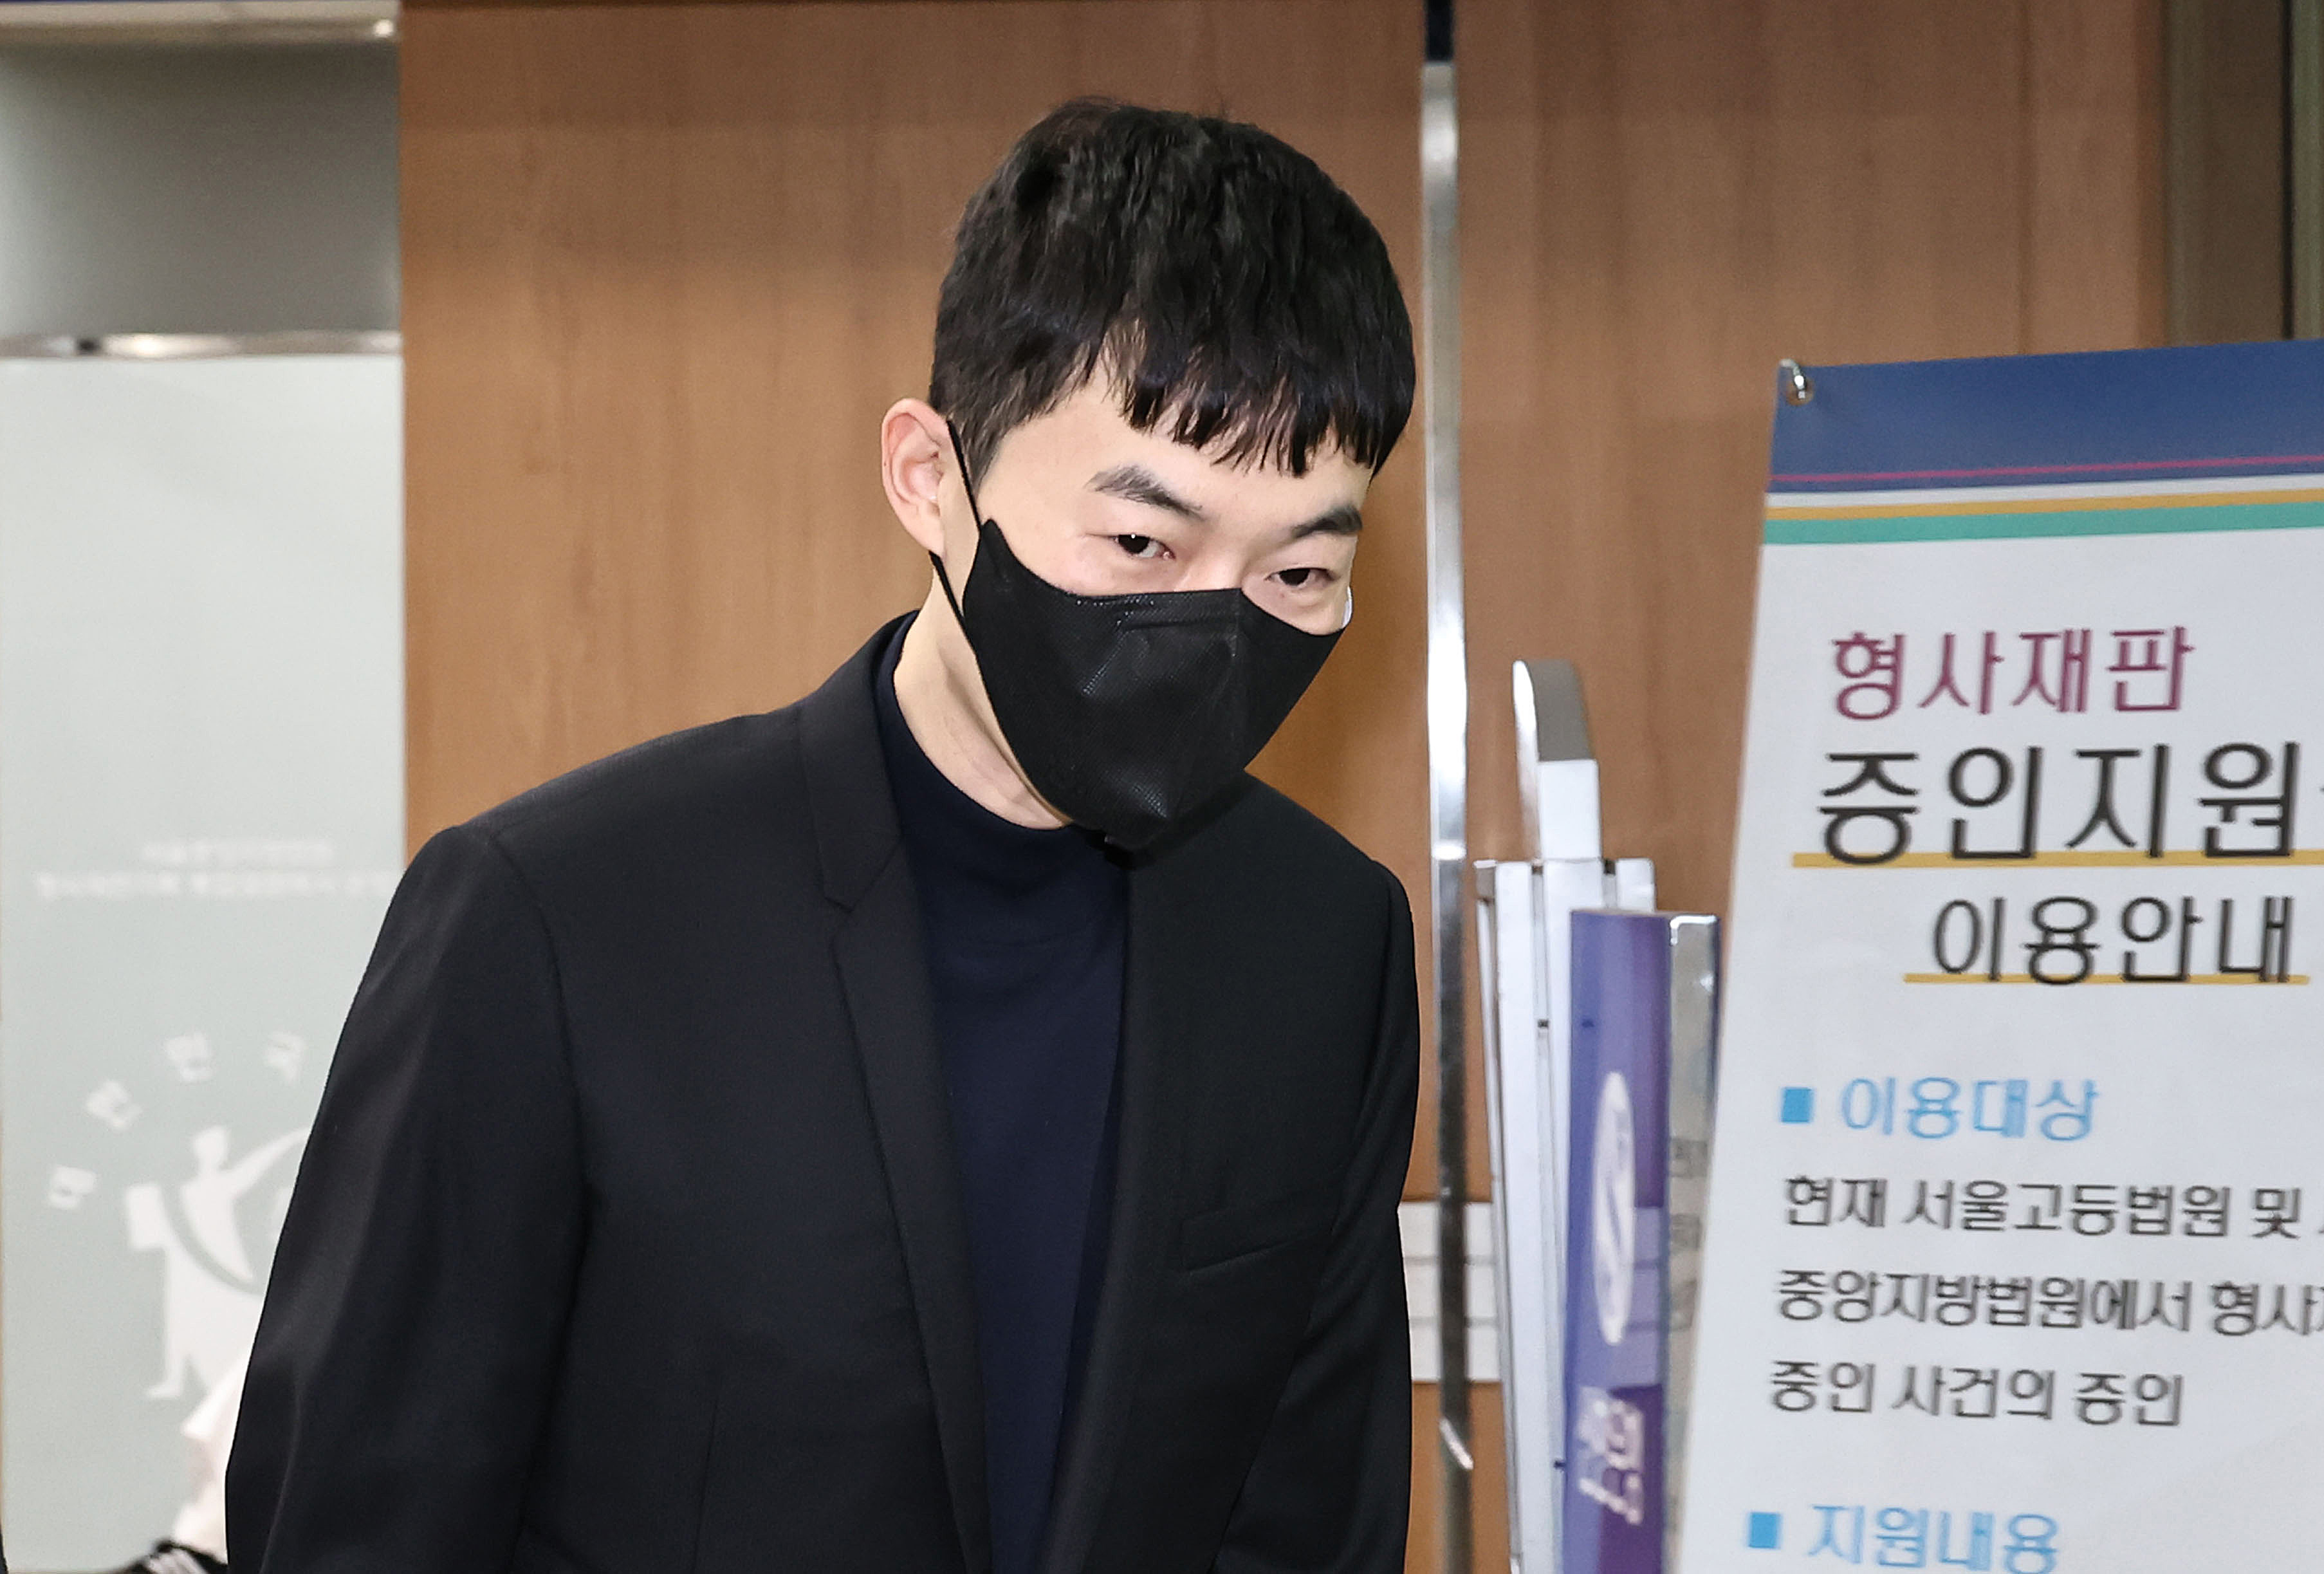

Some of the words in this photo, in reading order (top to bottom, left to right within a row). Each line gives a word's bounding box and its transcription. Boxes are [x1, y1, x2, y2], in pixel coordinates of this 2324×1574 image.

[1832, 626, 2195, 721] 형사재판
[1818, 741, 2324, 865] 증인지원
[1933, 896, 2294, 986] 이용안내
[1841, 1077, 2099, 1142] 이용대상
[1784, 1176, 1888, 1228] 현재
[1902, 1179, 2231, 1238] 서울고등법원
[2251, 1189, 2301, 1239] 및
[1778, 1270, 2193, 1333] 중앙지방법원에서
[2209, 1281, 2324, 1337] 형사
[1771, 1360, 1877, 1414] 중인
[1890, 1366, 2056, 1421] 사건의
[2074, 1373, 2184, 1427] 증인
[1808, 1505, 2059, 1574] 지원내용
